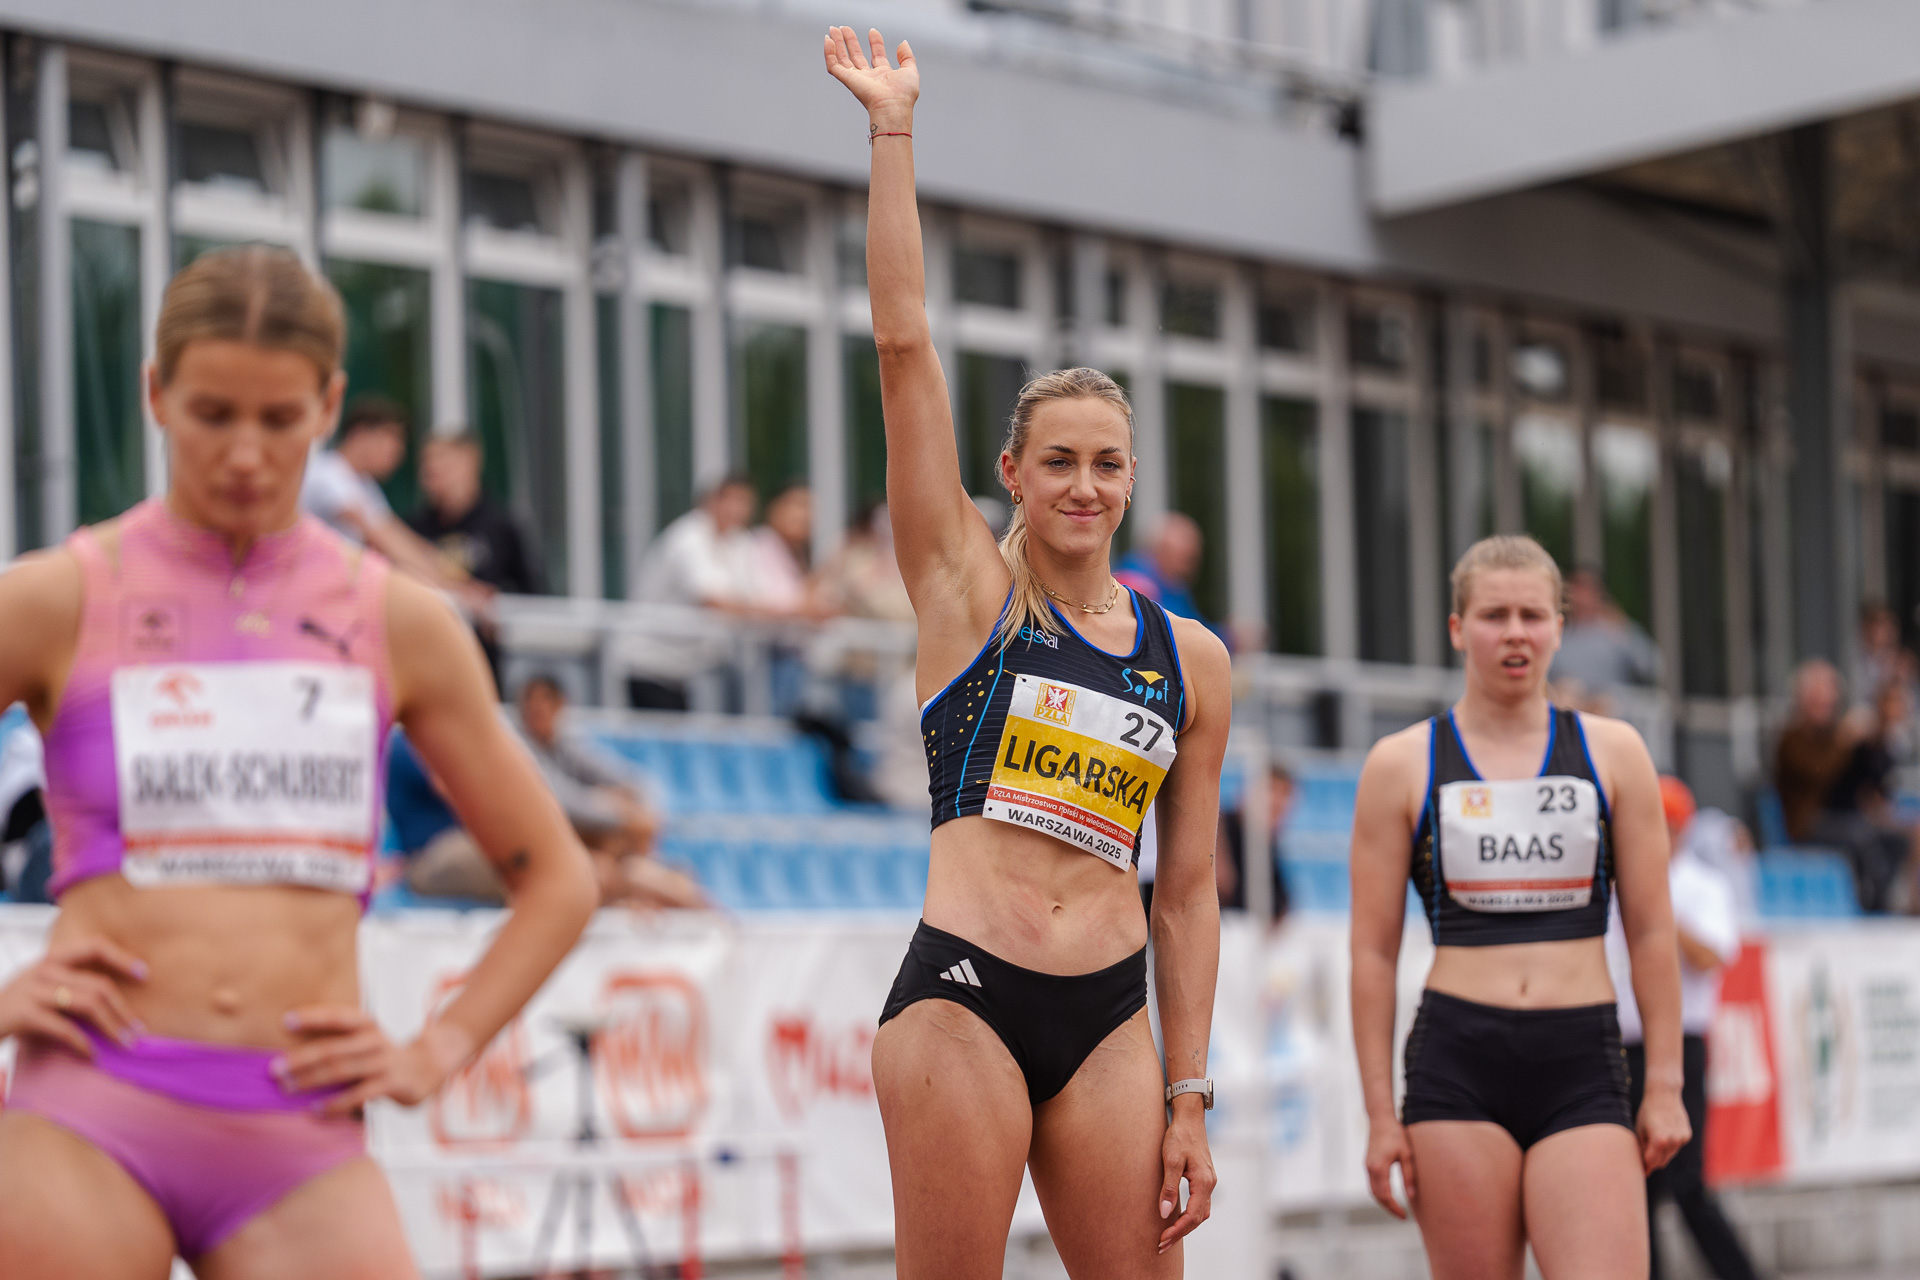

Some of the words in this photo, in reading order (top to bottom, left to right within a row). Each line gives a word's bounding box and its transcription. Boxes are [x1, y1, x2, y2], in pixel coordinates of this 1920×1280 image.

[295, 676, 322, 721] 7
[1121, 667, 1169, 706] Sopot
[1035, 706, 1068, 725] PZLA
[1119, 712, 1164, 752] 27
[1003, 734, 1150, 816] LIGARSKA
[993, 788, 1011, 799] PZLA
[1012, 793, 1058, 811] Mistrzostwa
[1058, 804, 1079, 819] Polski
[1538, 785, 1577, 813] 23
[1007, 808, 1093, 848] WARSZAWA
[1094, 838, 1122, 860] 2025
[1479, 834, 1564, 862] BAAS
